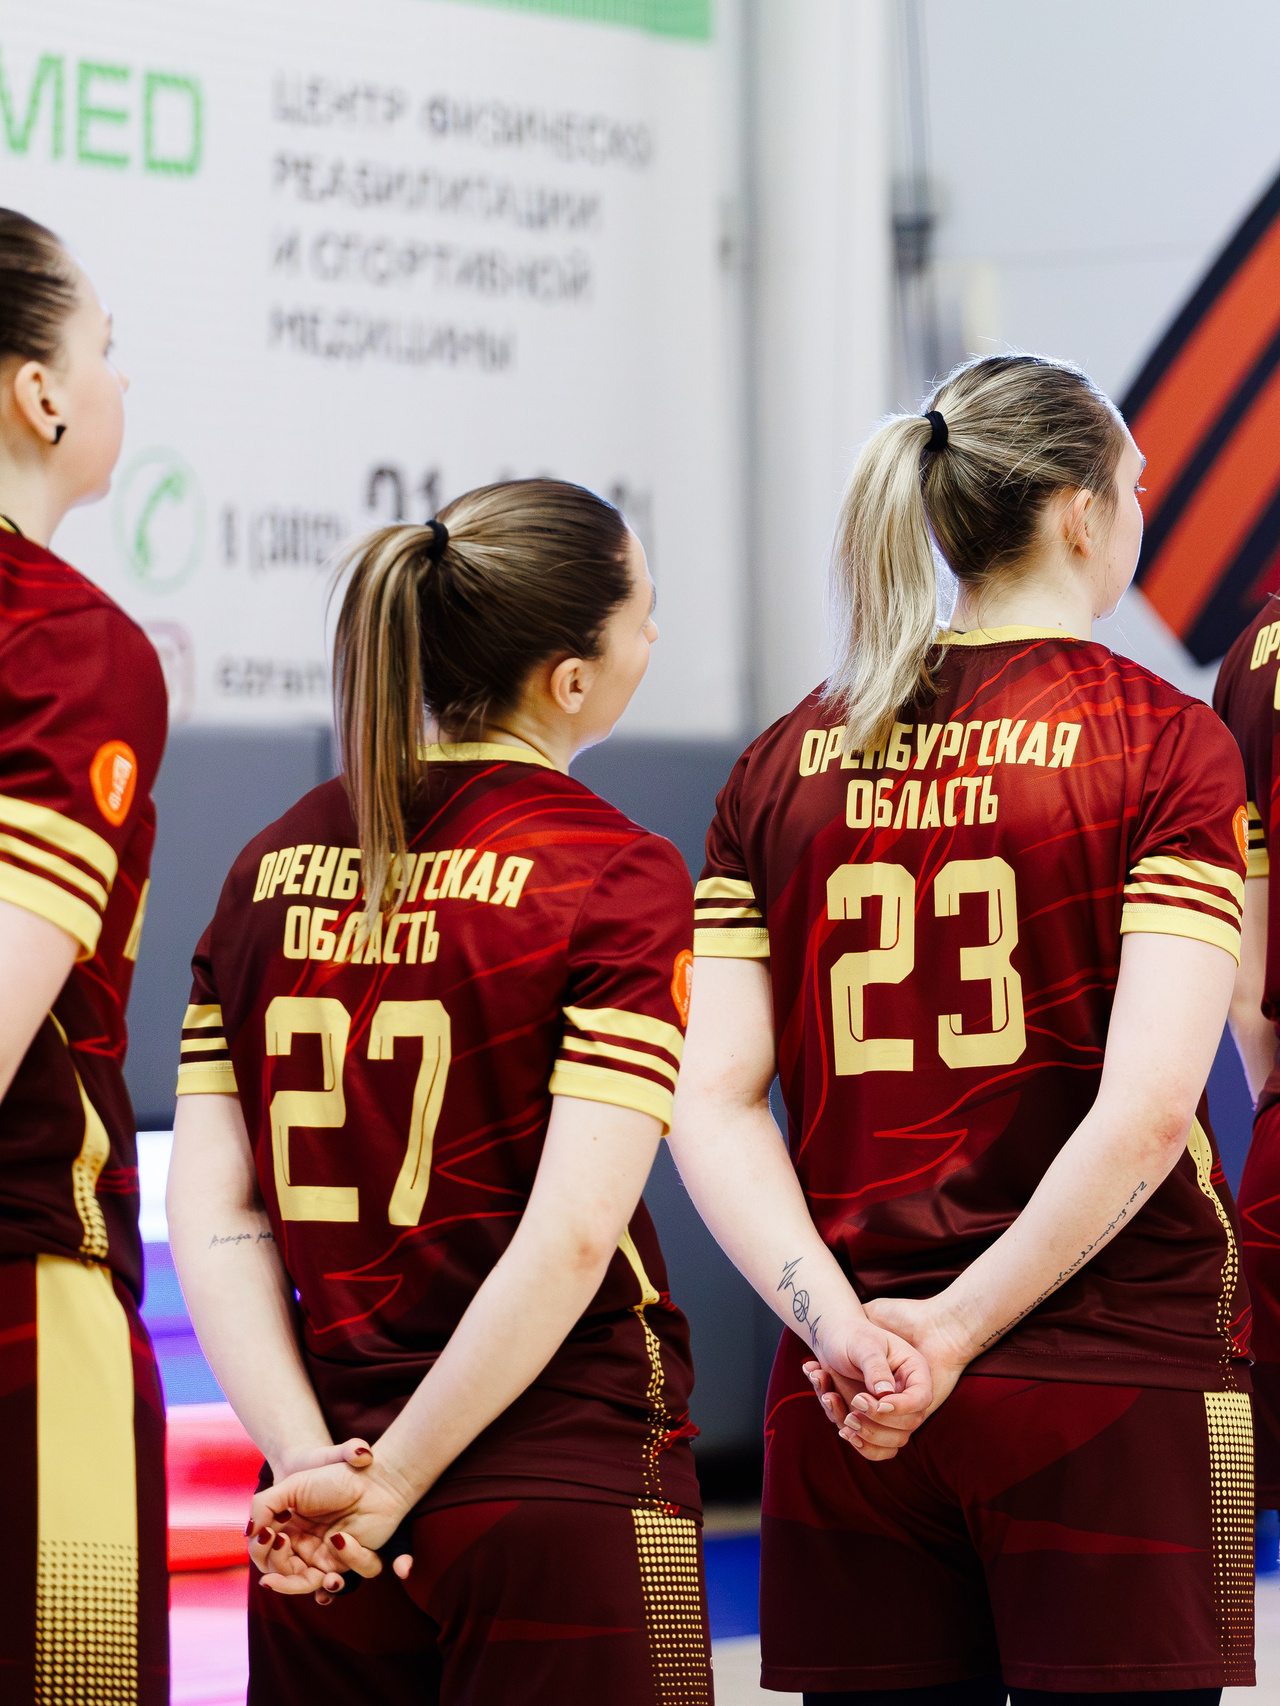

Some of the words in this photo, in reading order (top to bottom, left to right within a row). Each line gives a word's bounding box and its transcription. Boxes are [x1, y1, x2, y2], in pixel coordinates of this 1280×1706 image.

[846, 775, 999, 830] ОБЛАСТЬ
[253, 844, 534, 908] ОРЕНБРГСКАЯ
[283, 905, 440, 965] ОБЛАСТЬ
[826, 856, 1027, 1076] 23
[265, 996, 451, 1226] 27
